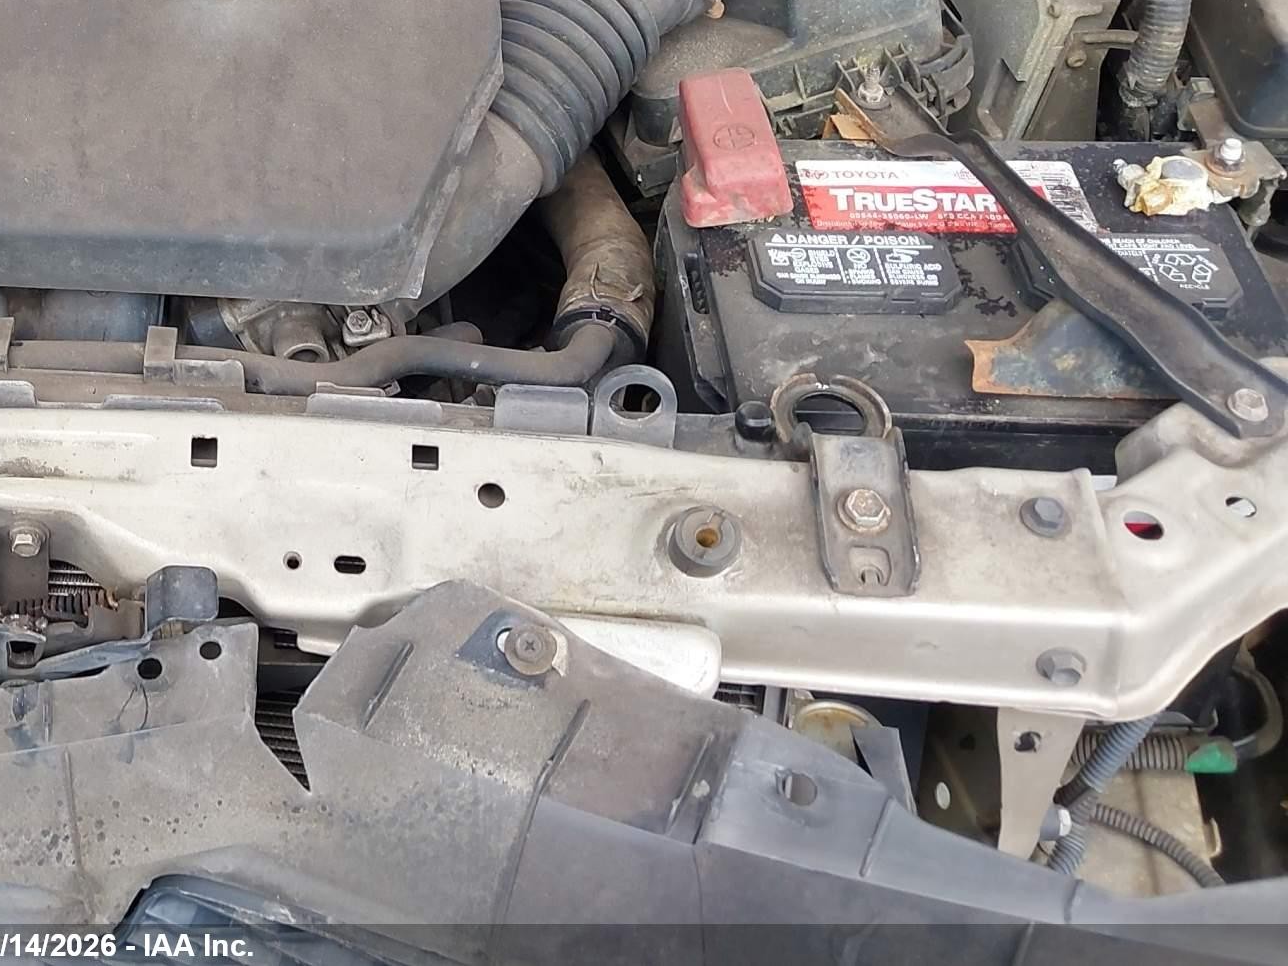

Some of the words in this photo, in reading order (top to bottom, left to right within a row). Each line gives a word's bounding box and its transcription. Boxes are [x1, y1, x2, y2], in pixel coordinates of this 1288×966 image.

[830, 170, 900, 180] TOYOTA
[828, 188, 998, 213] TRUESTAR
[786, 234, 848, 245] DANGER
[851, 234, 860, 245] /
[863, 235, 920, 246] POISON
